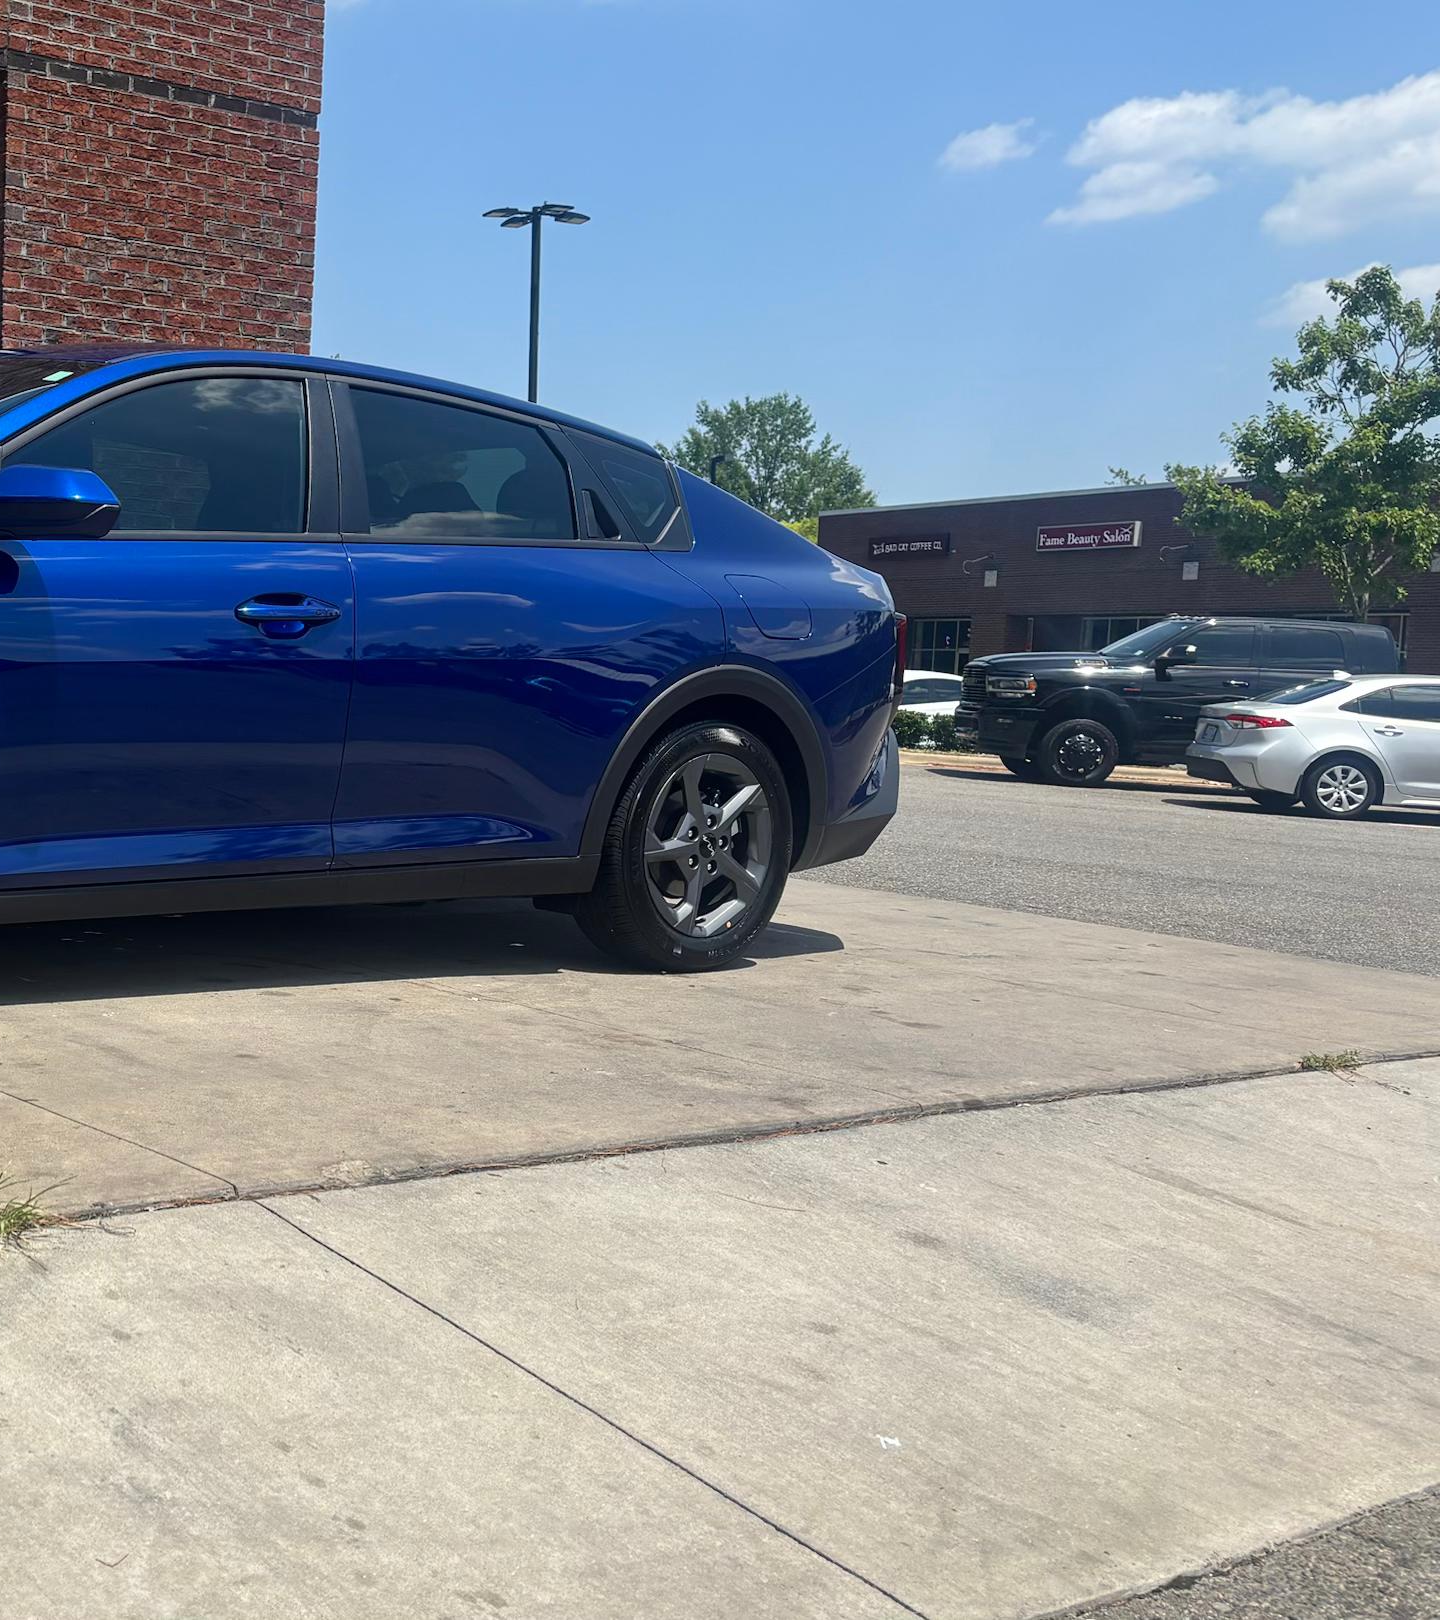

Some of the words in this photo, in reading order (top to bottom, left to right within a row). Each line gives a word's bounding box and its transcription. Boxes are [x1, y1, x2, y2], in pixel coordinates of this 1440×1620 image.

[1039, 534, 1065, 546] Fame
[1067, 533, 1101, 547] Beauty
[1103, 529, 1130, 543] Salon
[885, 543, 897, 553] BAD
[898, 543, 909, 551] CAT
[910, 541, 932, 551] COFFEE
